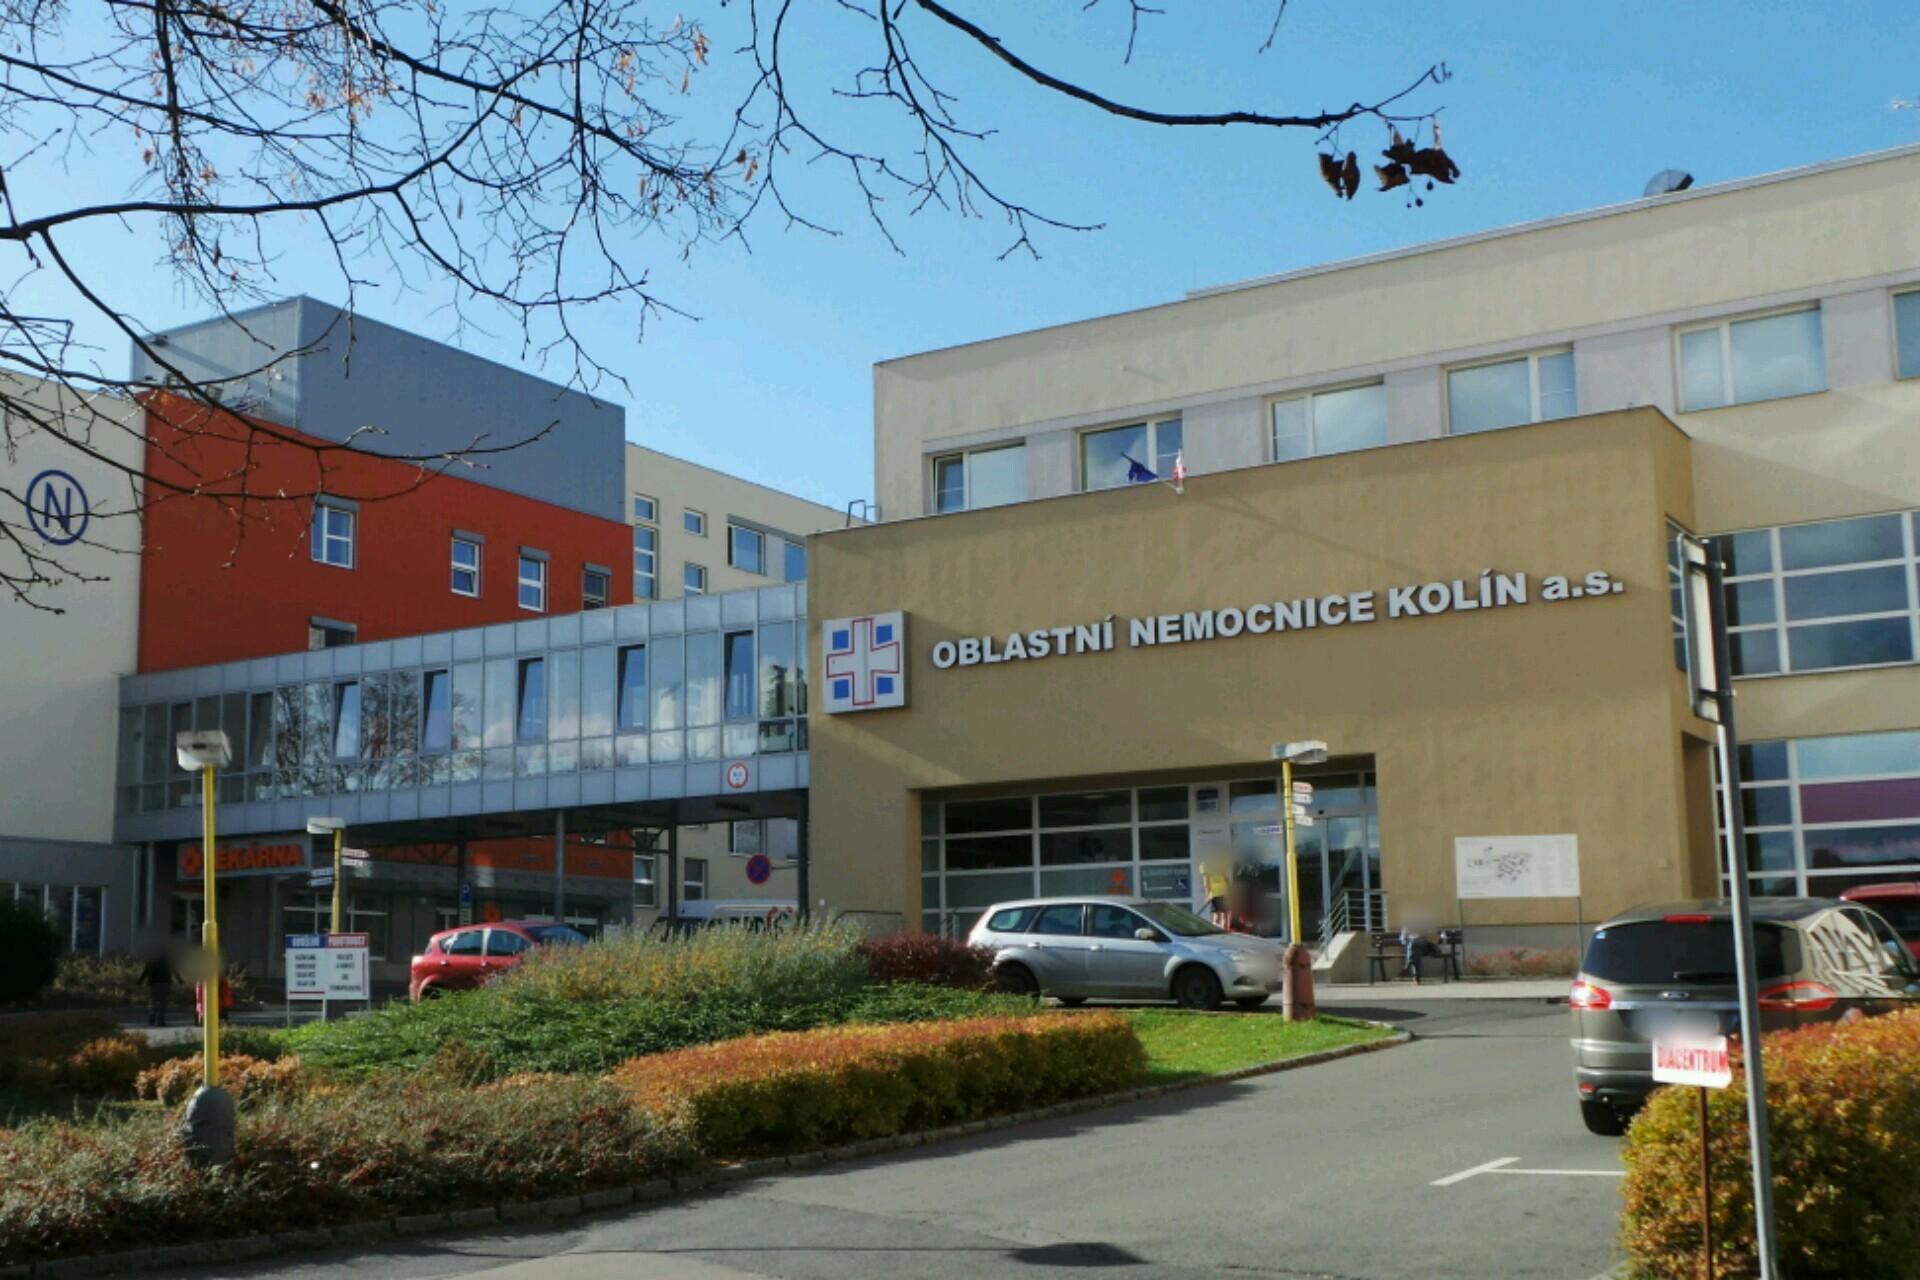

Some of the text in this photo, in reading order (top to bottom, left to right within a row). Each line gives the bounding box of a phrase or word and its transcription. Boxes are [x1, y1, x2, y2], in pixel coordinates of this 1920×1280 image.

[932, 568, 1626, 669] OBLASTNÍ NEMOCNICE KOLÍN a.s.
[206, 841, 304, 871] ÉKÁRNA
